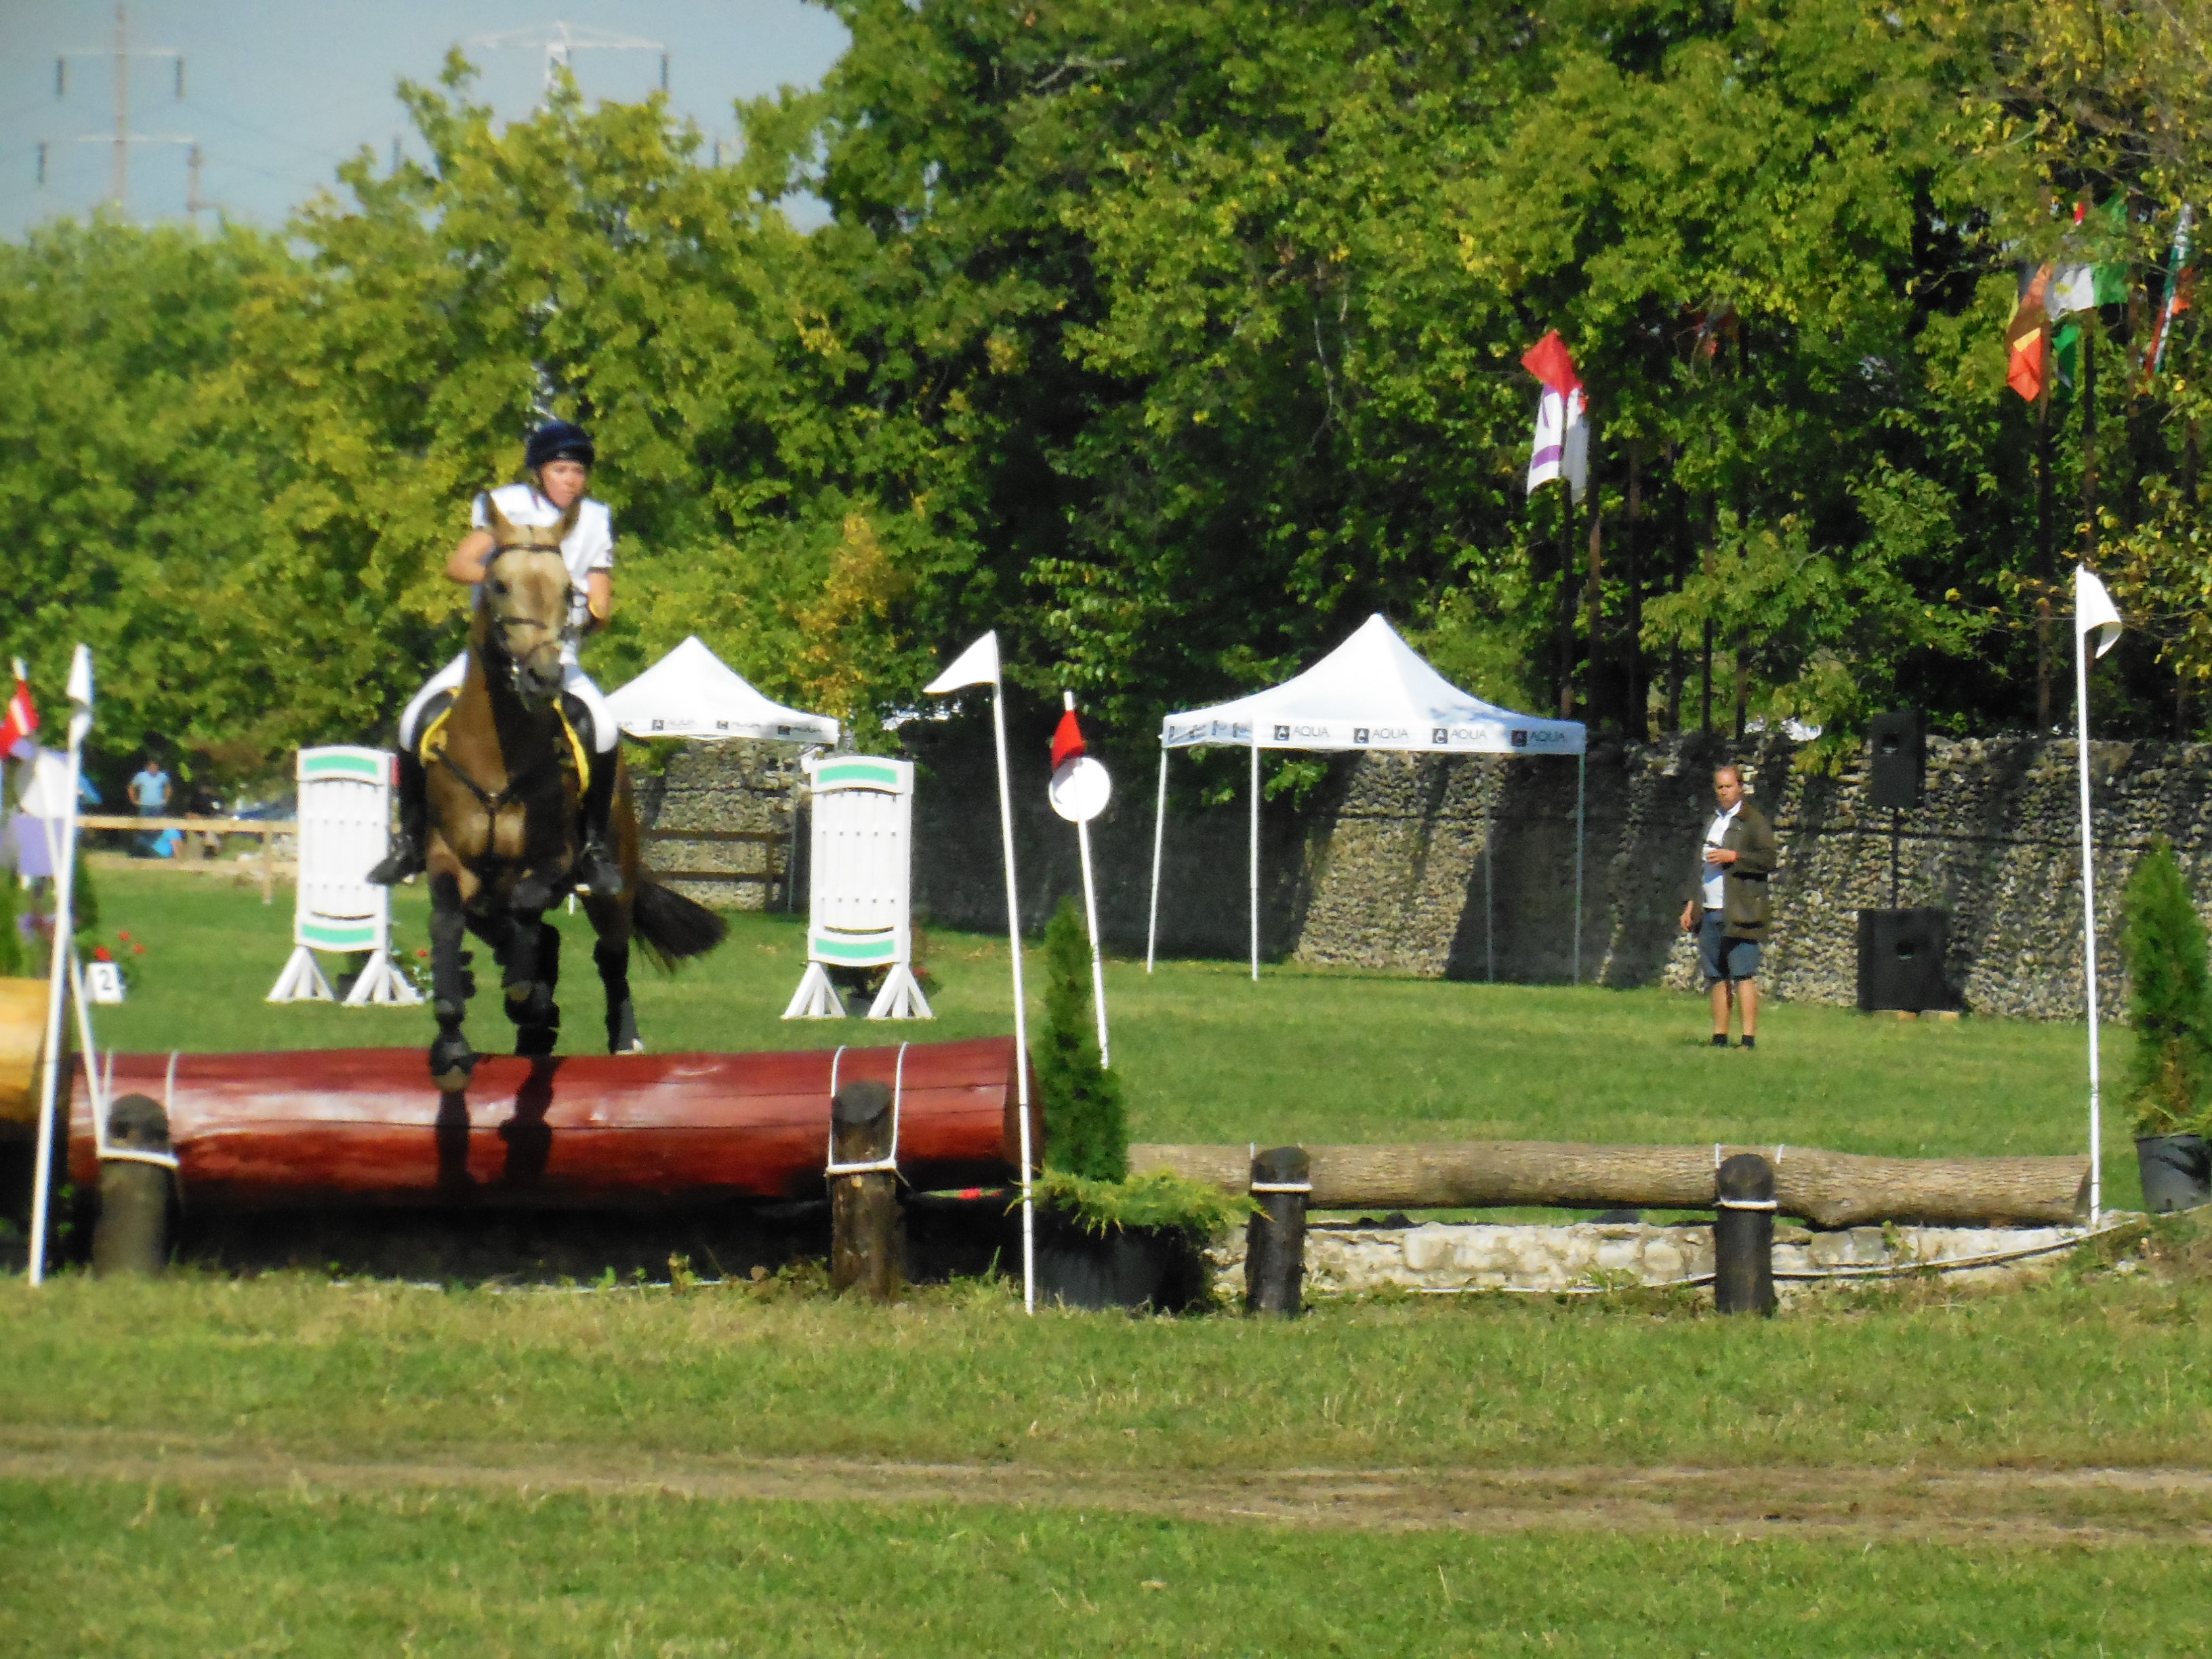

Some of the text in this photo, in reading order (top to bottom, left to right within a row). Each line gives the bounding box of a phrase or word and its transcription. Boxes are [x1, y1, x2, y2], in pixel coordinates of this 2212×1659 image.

[1293, 726, 1330, 737] AQUA
[1371, 728, 1409, 739] AQUA
[1451, 729, 1487, 740] AQUA
[1529, 731, 1566, 742] AQUA
[98, 969, 112, 990] 2
